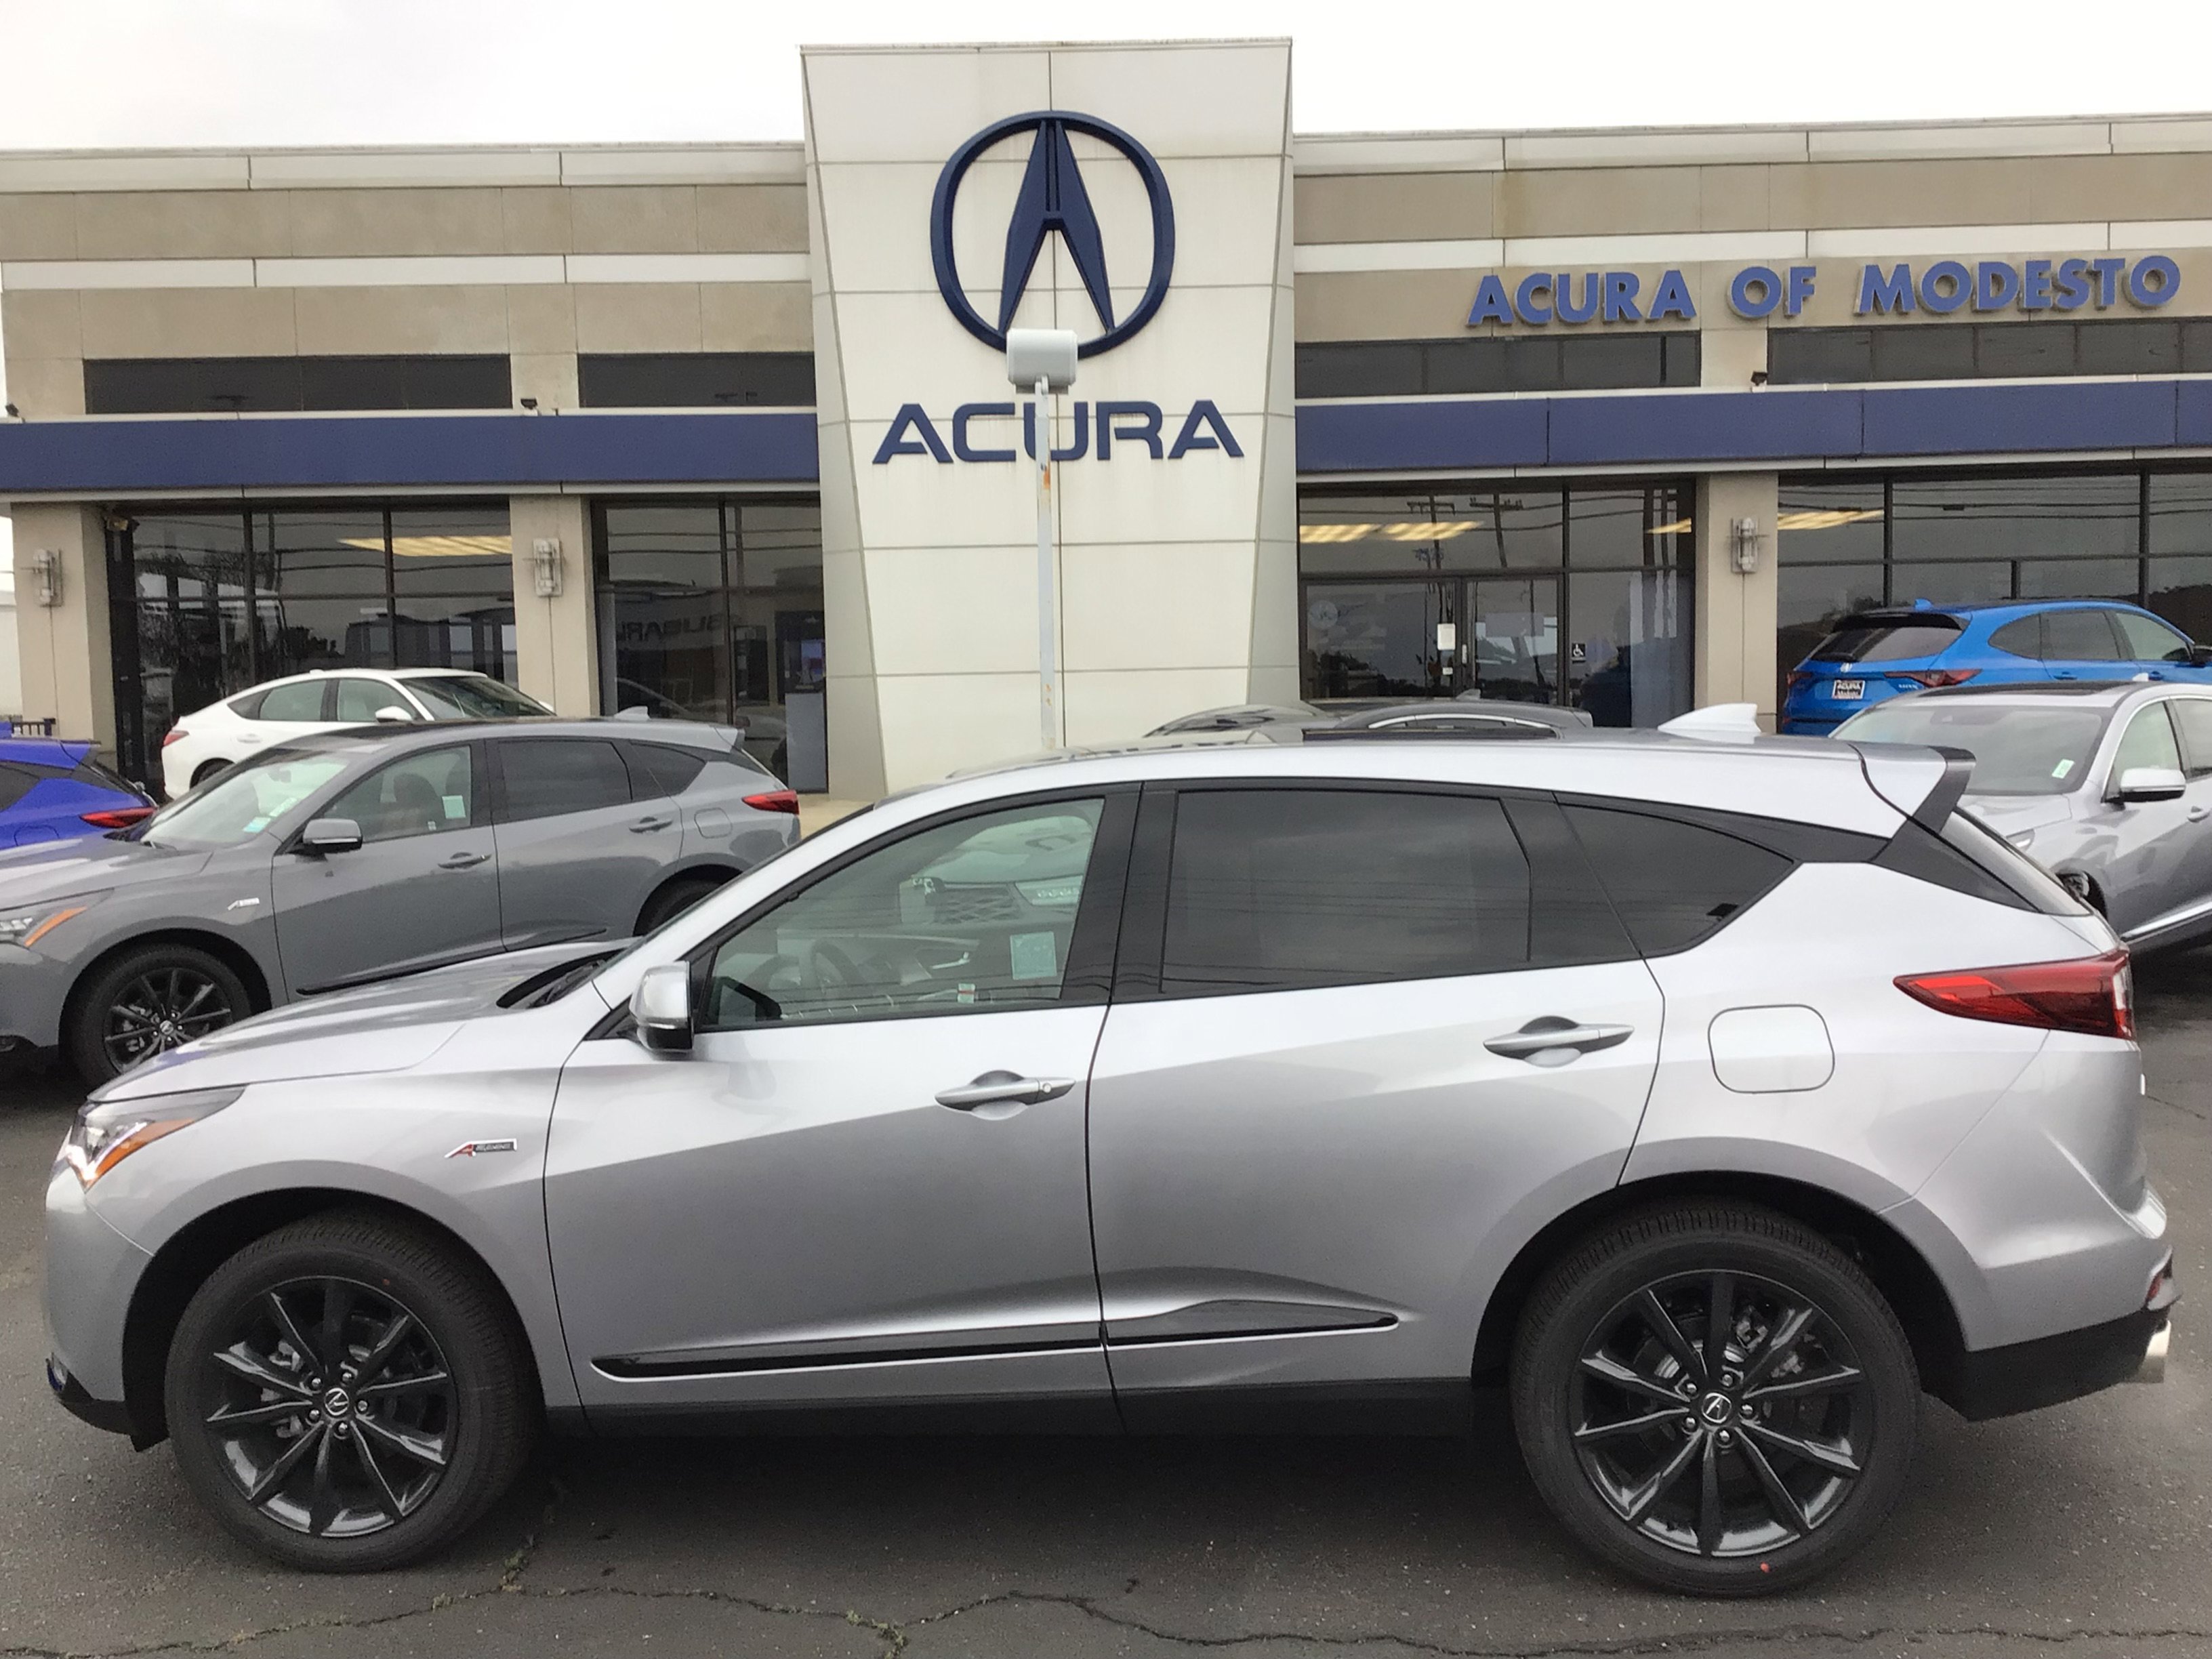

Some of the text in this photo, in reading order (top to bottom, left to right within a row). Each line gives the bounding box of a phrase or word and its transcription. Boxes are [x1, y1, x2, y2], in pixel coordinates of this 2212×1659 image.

[1467, 255, 2181, 327] ACURA OF MODESTO
[872, 400, 1245, 464] ACURA
